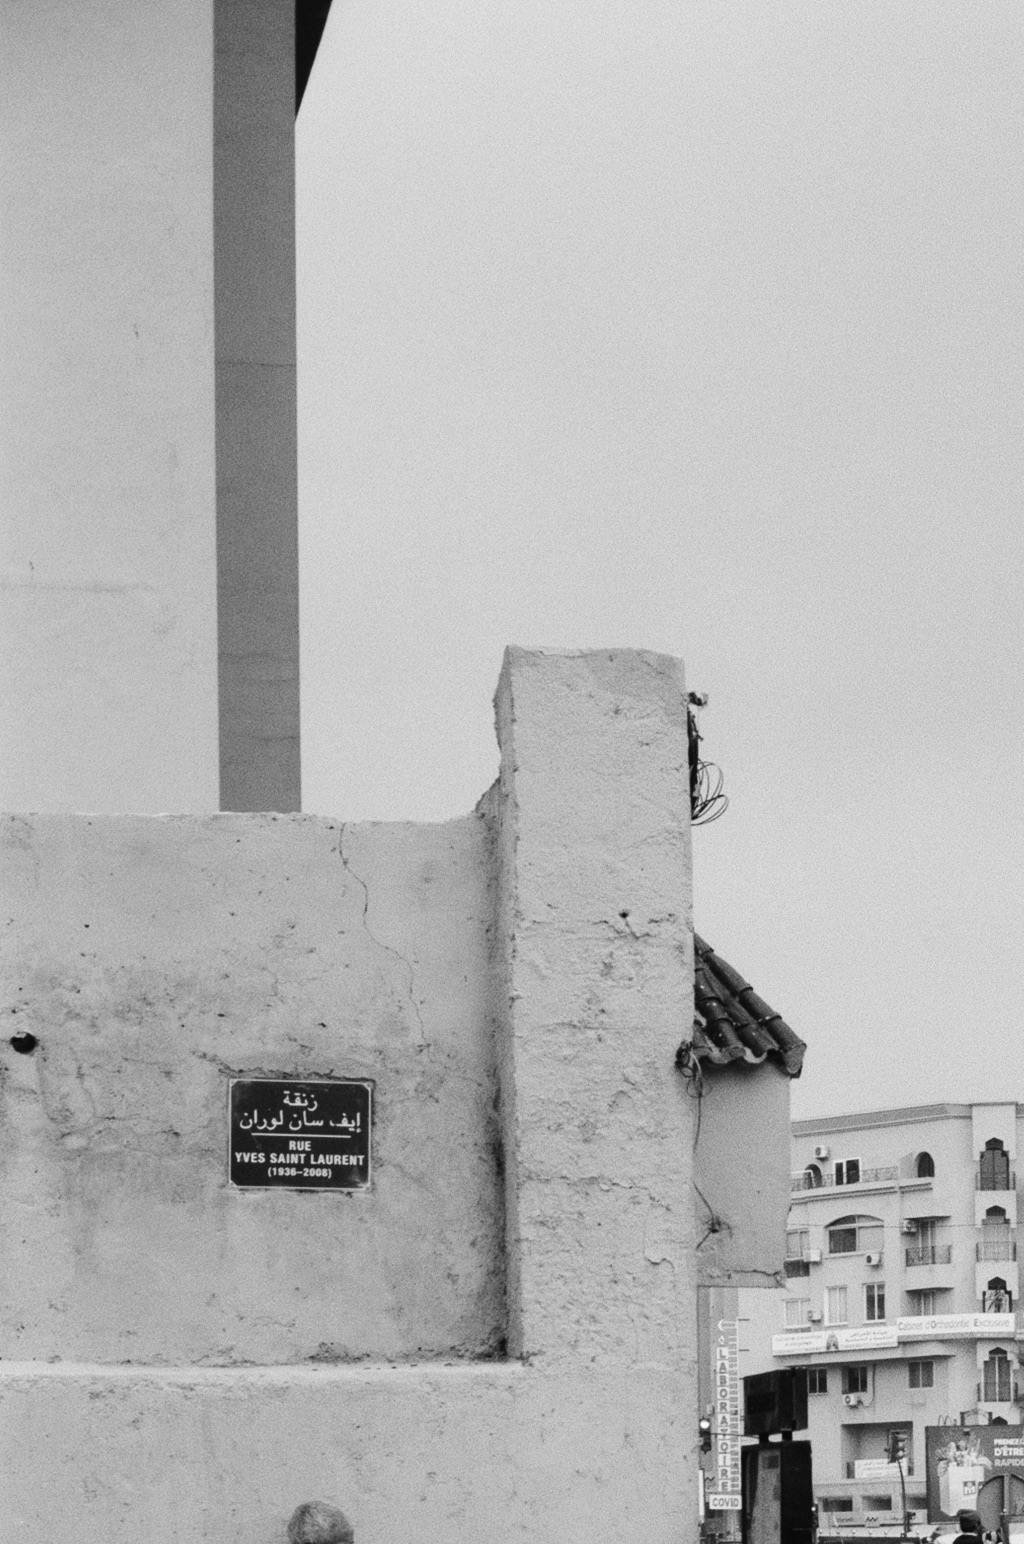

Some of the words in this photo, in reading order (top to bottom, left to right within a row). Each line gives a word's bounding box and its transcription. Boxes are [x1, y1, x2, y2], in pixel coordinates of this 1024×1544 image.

[283, 1090, 318, 1112] زنقة
[239, 1109, 284, 1130] لوران
[289, 1110, 324, 1130] سان
[329, 1112, 362, 1134] إيف
[289, 1140, 312, 1151] RUE
[235, 1152, 266, 1163] YVES
[269, 1152, 307, 1165] SAINT
[310, 1154, 365, 1166] LAURENT
[718, 1348, 730, 1491] LABORATOIRE
[712, 1497, 739, 1508] COVID
